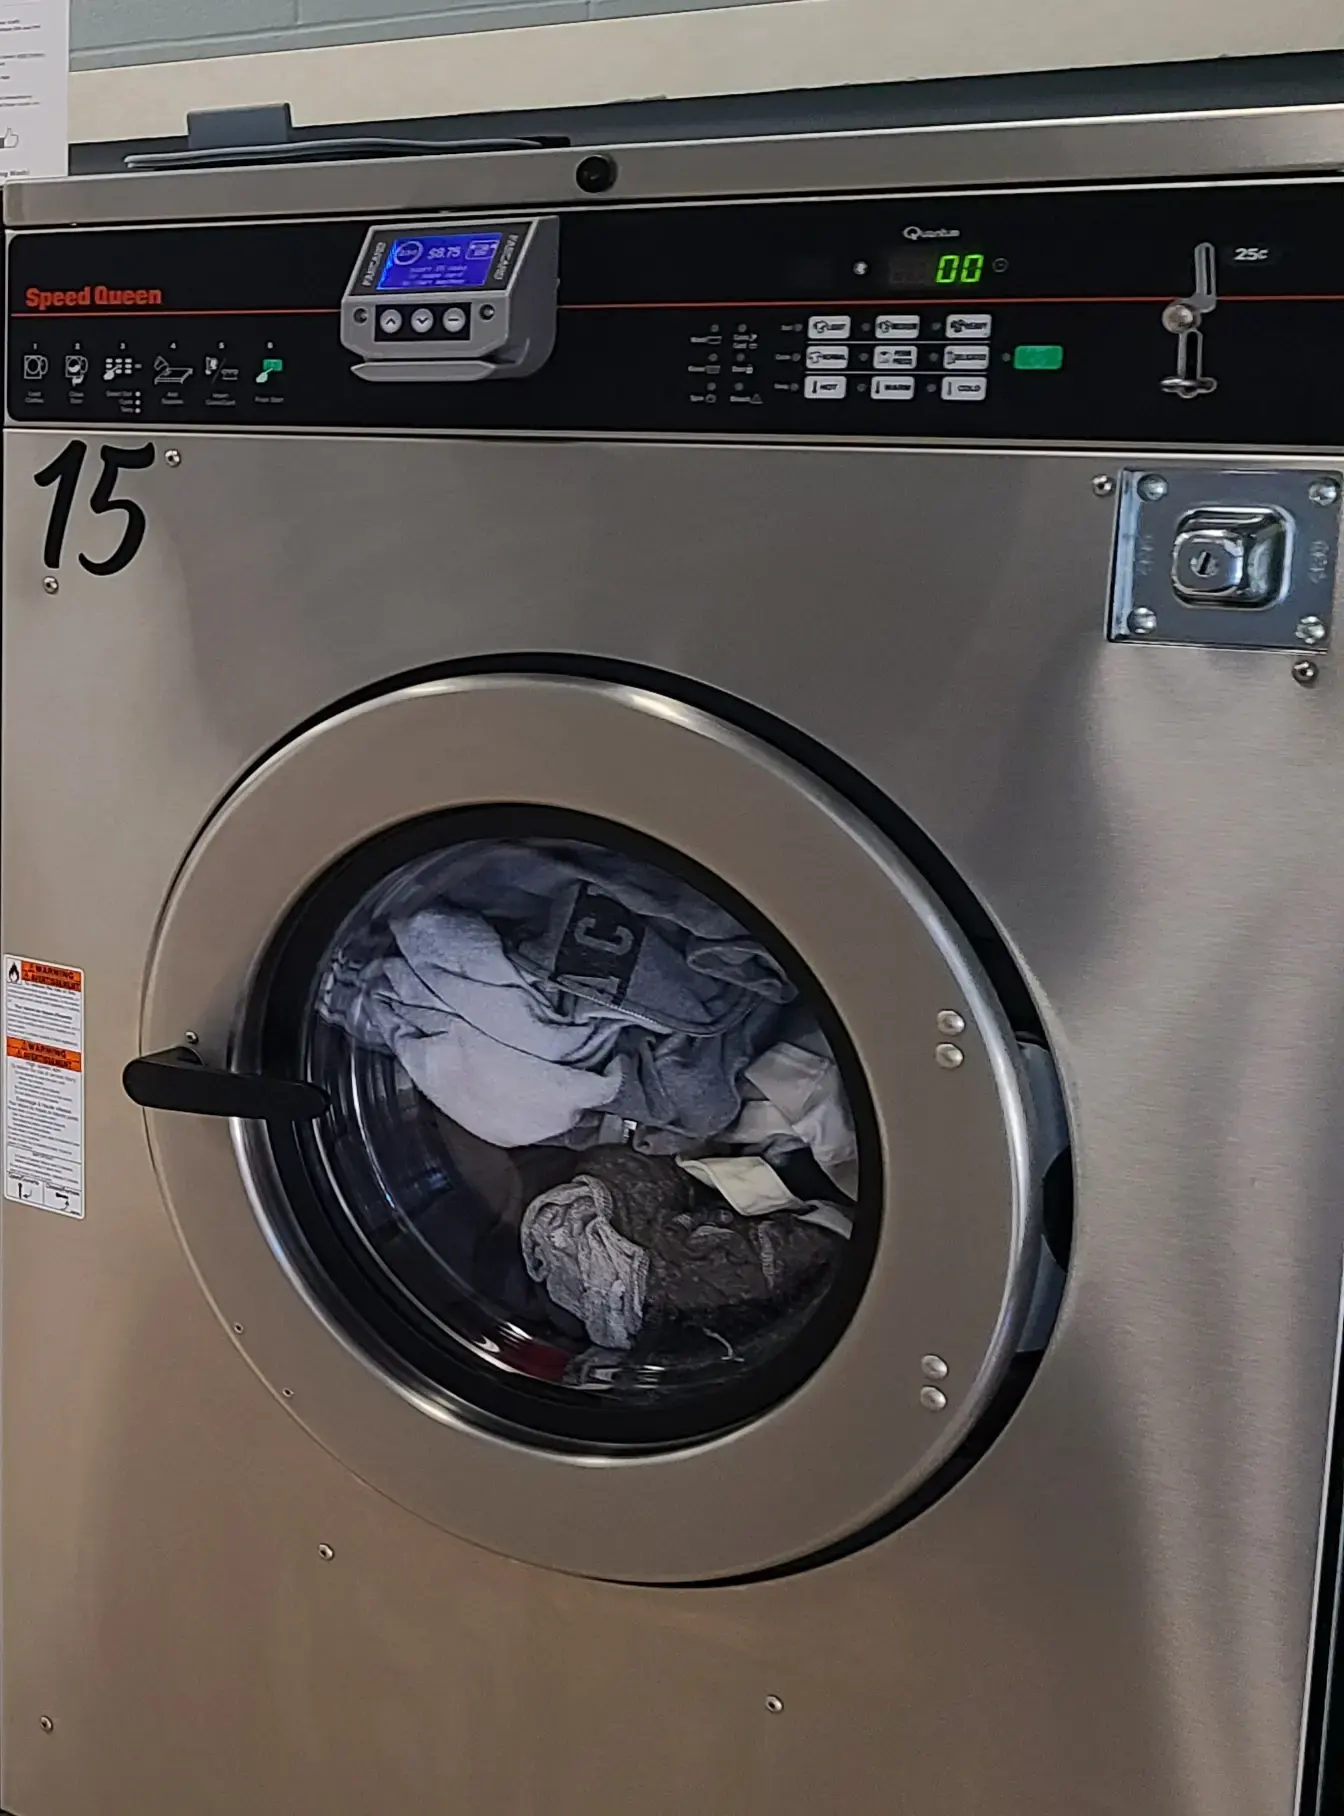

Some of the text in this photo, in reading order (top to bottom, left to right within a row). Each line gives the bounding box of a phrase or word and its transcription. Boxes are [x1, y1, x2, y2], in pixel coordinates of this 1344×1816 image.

[1234, 247, 1269, 261] 25¢
[936, 254, 984, 283] 00
[25, 286, 163, 310] Speed Queen
[33, 439, 155, 576] 15
[34, 963, 74, 980] WARNING
